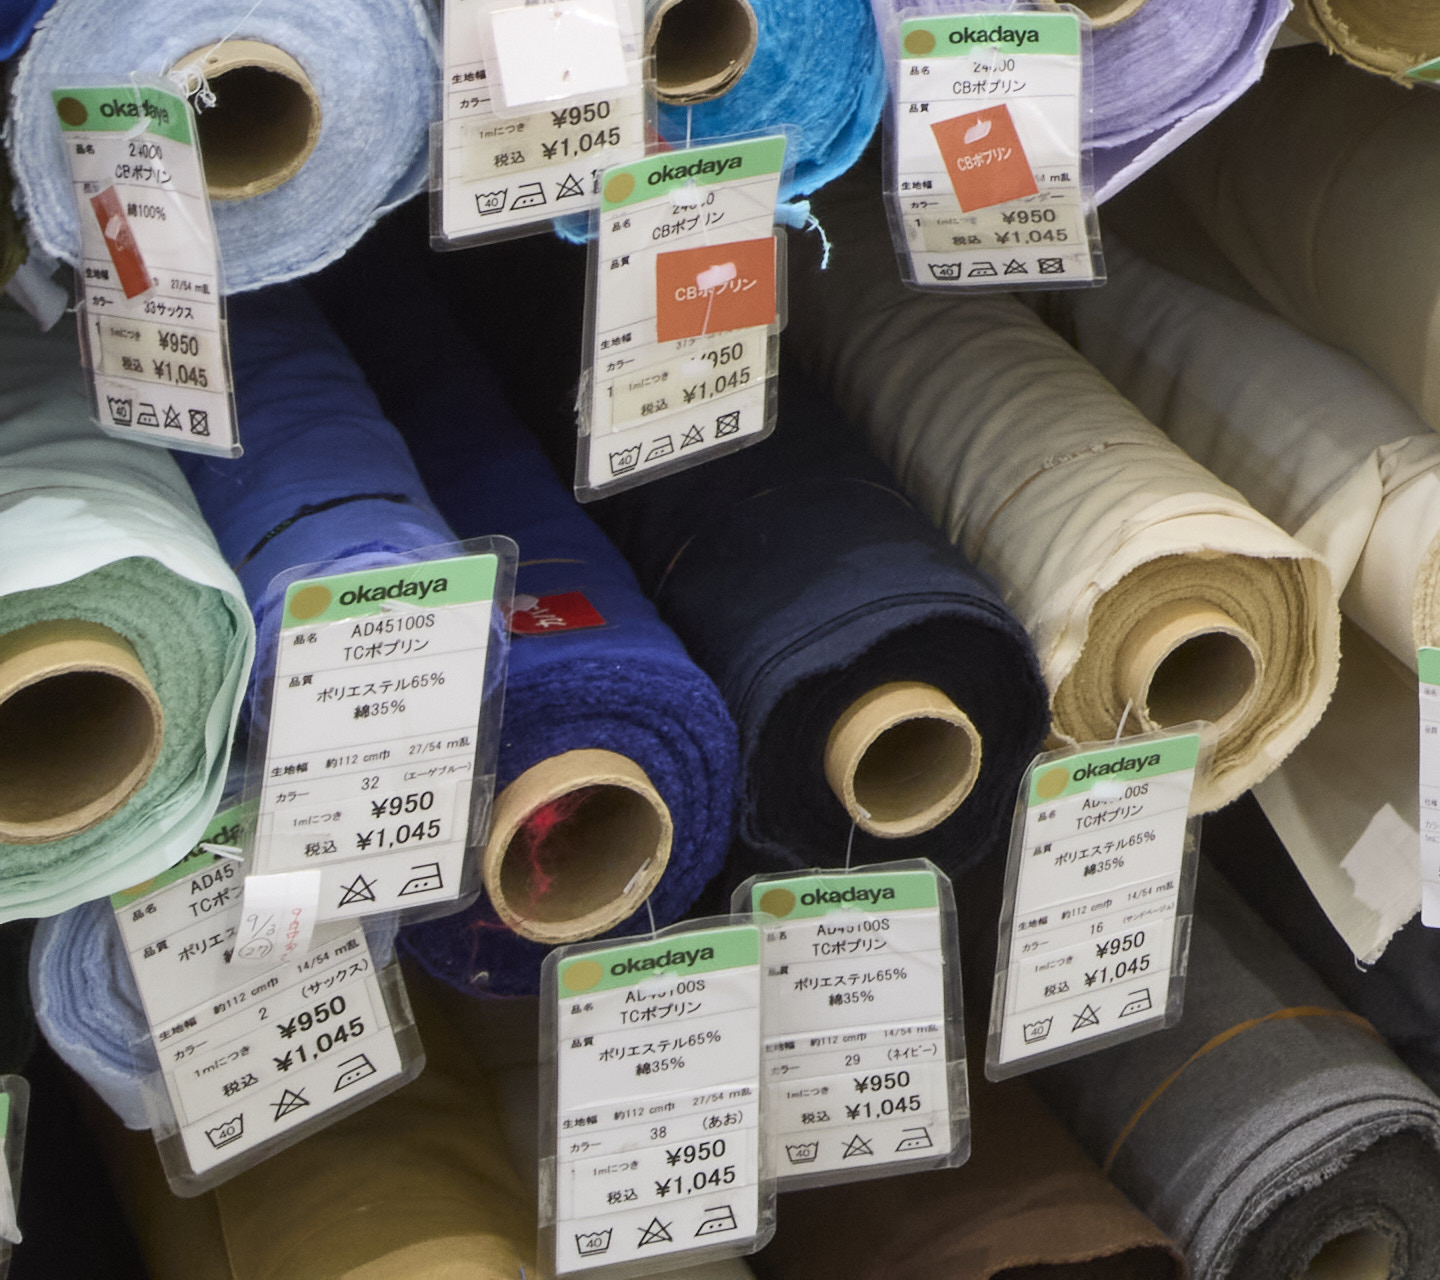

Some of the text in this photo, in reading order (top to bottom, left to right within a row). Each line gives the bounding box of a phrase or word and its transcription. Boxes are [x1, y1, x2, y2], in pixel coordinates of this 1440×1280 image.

[541, 127, 620, 159] ¥1,045
[339, 578, 447, 605] okadaya
[351, 614, 435, 638] AD45100S
[344, 639, 429, 661] TCポプリン
[317, 672, 445, 702] ポリエステル65%
[354, 699, 405, 719] 綿35%
[1073, 754, 1160, 781] okadaya
[372, 791, 434, 818] ¥950
[304, 819, 440, 857] 税込 ¥1,045
[611, 947, 714, 976] okadaya
[1085, 954, 1150, 987] ¥1,045
[888, 1043, 937, 1061] (ネイビー)
[703, 1111, 742, 1130] (あお)
